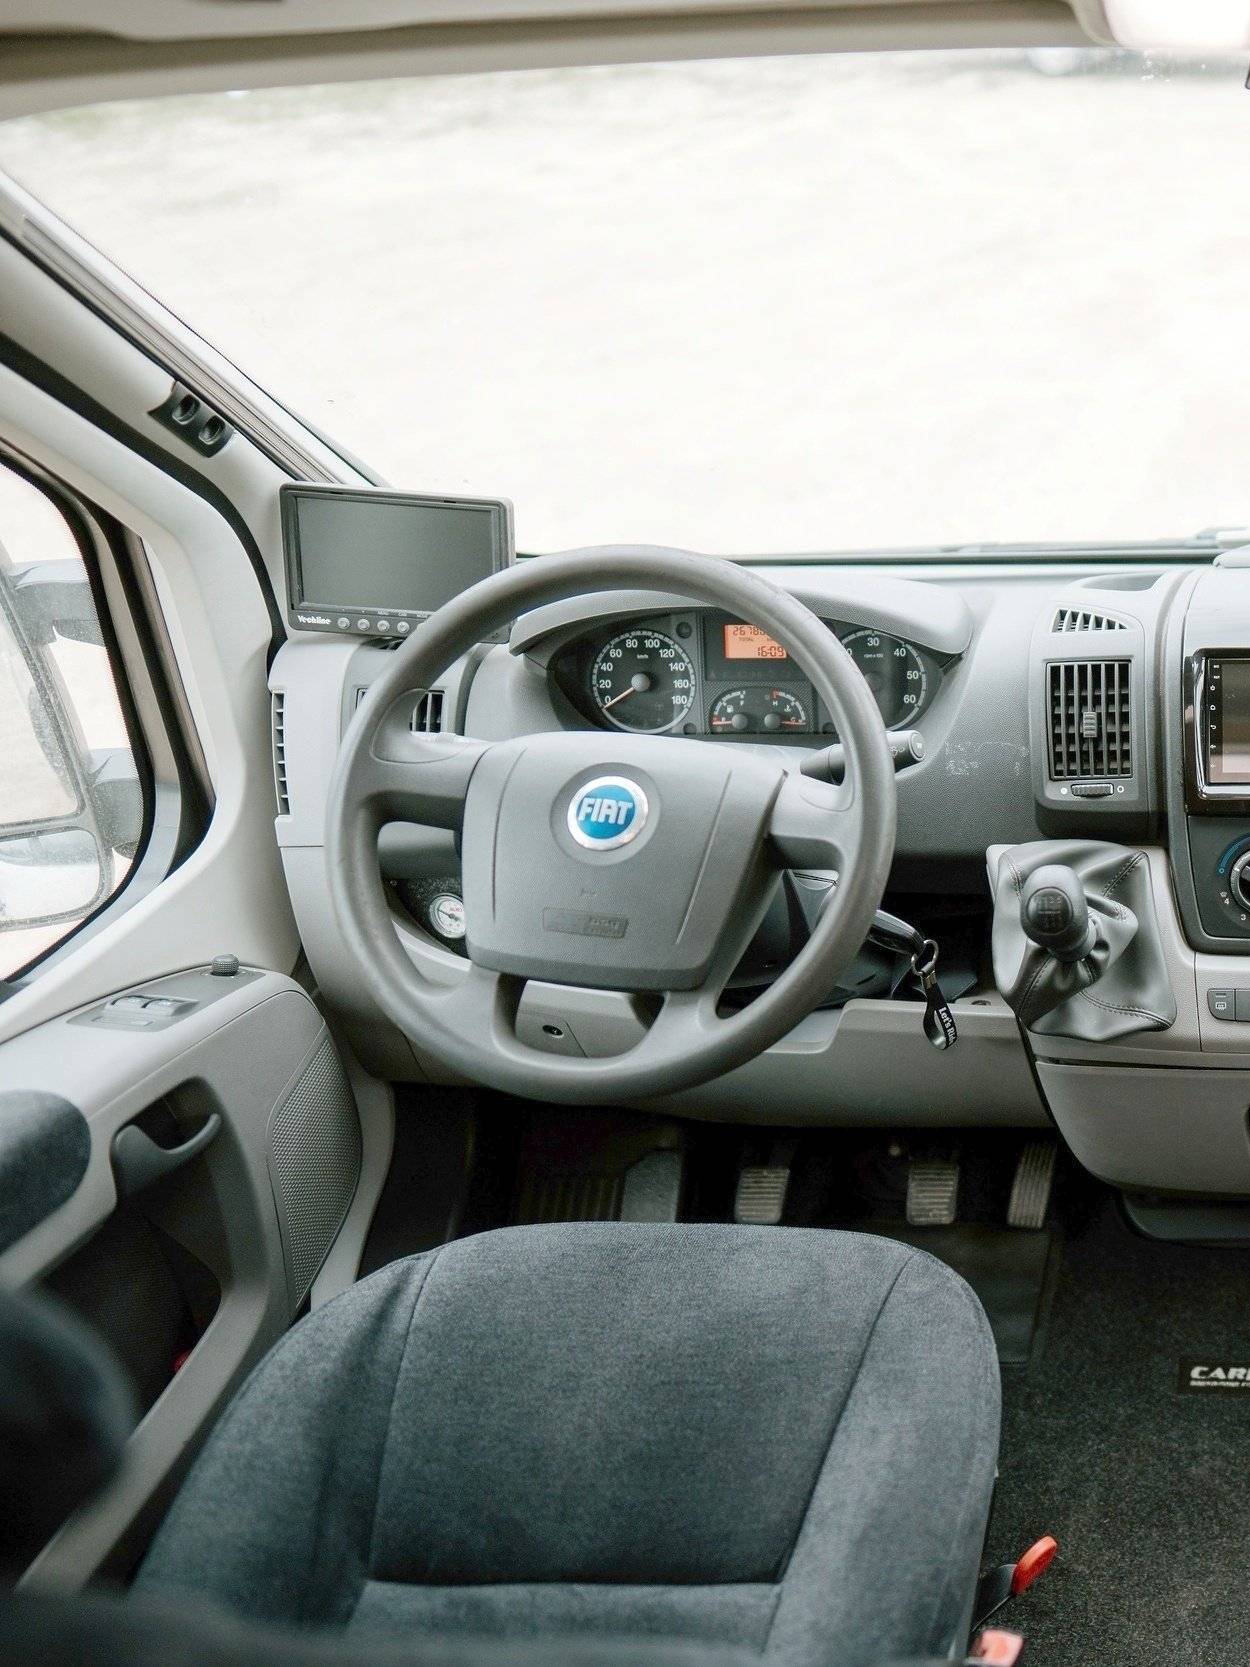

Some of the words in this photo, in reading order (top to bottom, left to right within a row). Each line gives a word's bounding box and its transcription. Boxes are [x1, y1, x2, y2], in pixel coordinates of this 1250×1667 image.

[626, 639, 638, 648] 80
[644, 639, 660, 648] 100
[867, 638, 880, 646] 30
[609, 649, 622, 658] 60
[659, 649, 675, 658] 120
[893, 648, 907, 657] 40
[600, 663, 613, 671] 40
[669, 663, 685, 671] 140
[906, 671, 919, 680] 50
[600, 680, 612, 689] 20
[673, 680, 689, 689] 160
[604, 696, 612, 704] 0
[672, 696, 688, 704] 180
[903, 695, 917, 704] 60
[579, 797, 634, 825] FIAT
[939, 1007, 952, 1028] Let's
